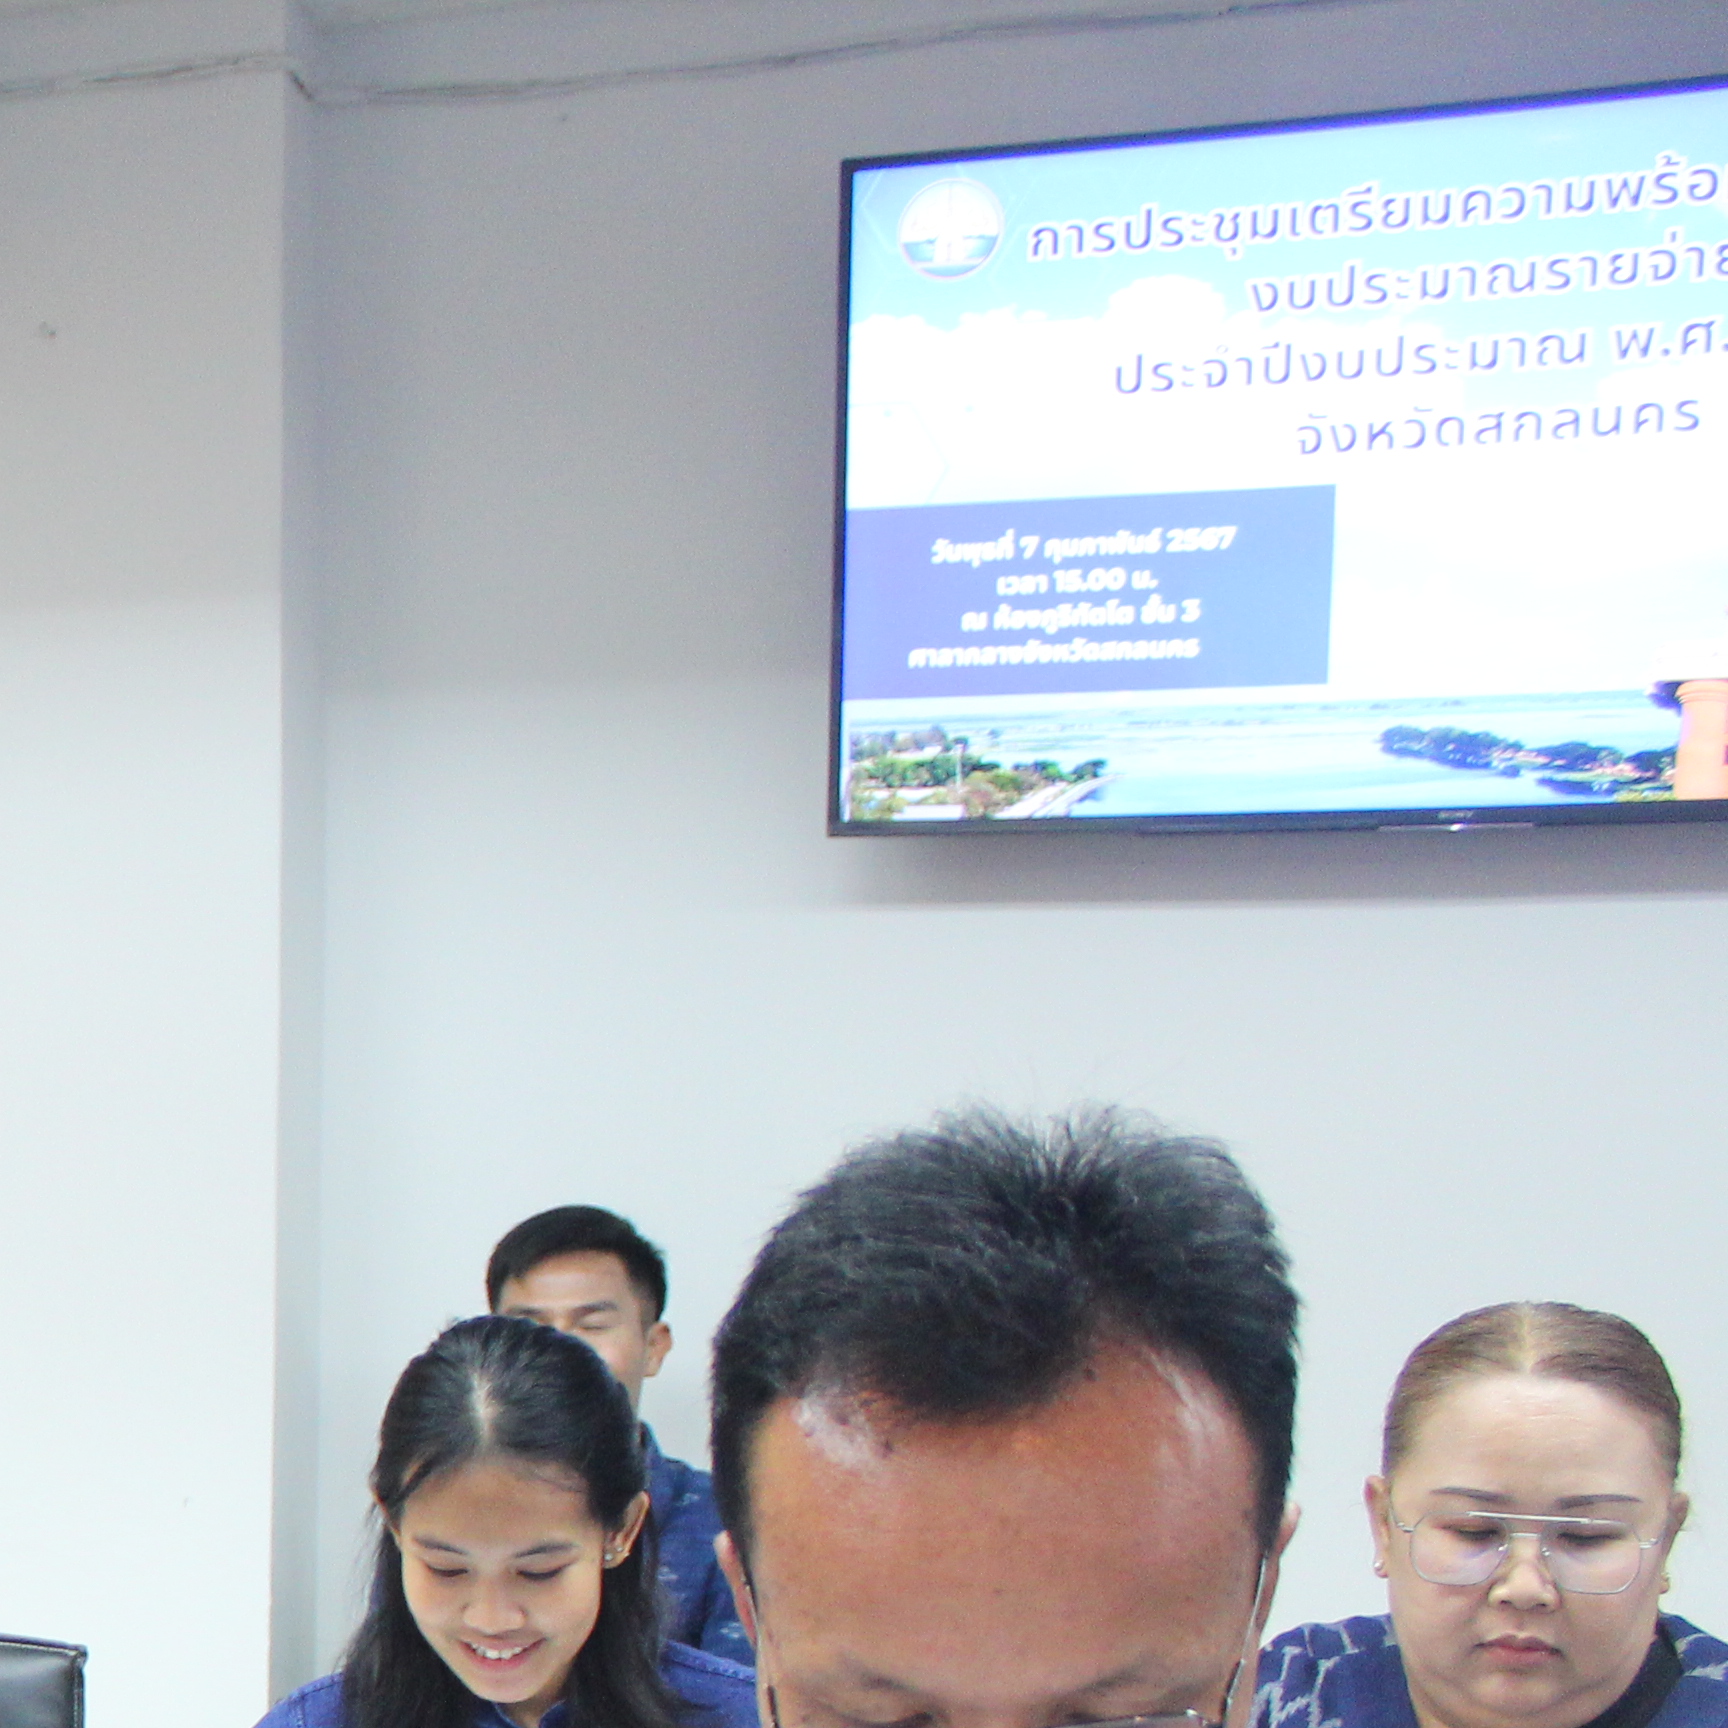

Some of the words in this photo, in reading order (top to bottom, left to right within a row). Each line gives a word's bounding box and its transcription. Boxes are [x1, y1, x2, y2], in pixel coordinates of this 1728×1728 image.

[1031, 152, 1728, 260] การประชุมเตรียมความพร้อ
[1114, 330, 1587, 396] ประจำปีงบประมาณ
[1296, 398, 1701, 456] จังหวัดสกลนคร
[1019, 535, 1040, 560] 7
[1164, 525, 1238, 553] 2567
[996, 573, 1049, 596] เวลา
[1052, 566, 1127, 594] 15.00
[1130, 569, 1160, 591] น.
[1180, 598, 1202, 623] 3
